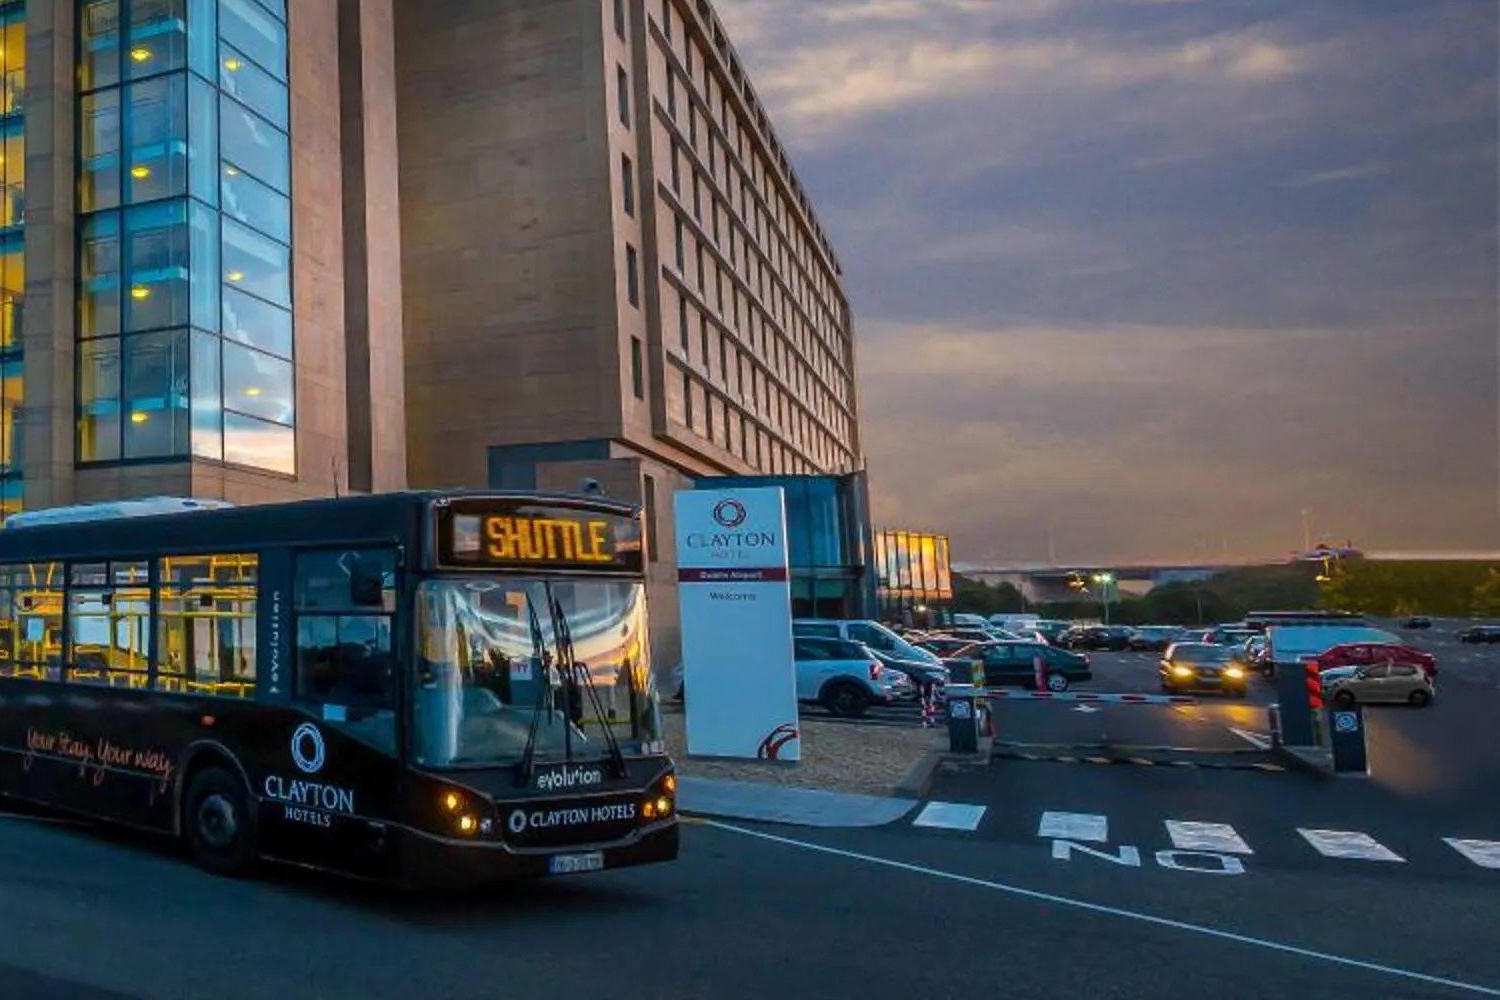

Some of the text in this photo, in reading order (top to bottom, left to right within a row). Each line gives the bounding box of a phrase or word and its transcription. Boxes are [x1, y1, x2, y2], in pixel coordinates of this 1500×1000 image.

[485, 514, 614, 562] SHUTTLE
[686, 531, 775, 549] CLAYTON
[92, 736, 133, 786] Your
[537, 765, 601, 790] evolution
[264, 775, 354, 813] CLAYTON
[285, 806, 332, 828] HOTELS
[529, 802, 637, 828] CLAYTON HOTELS
